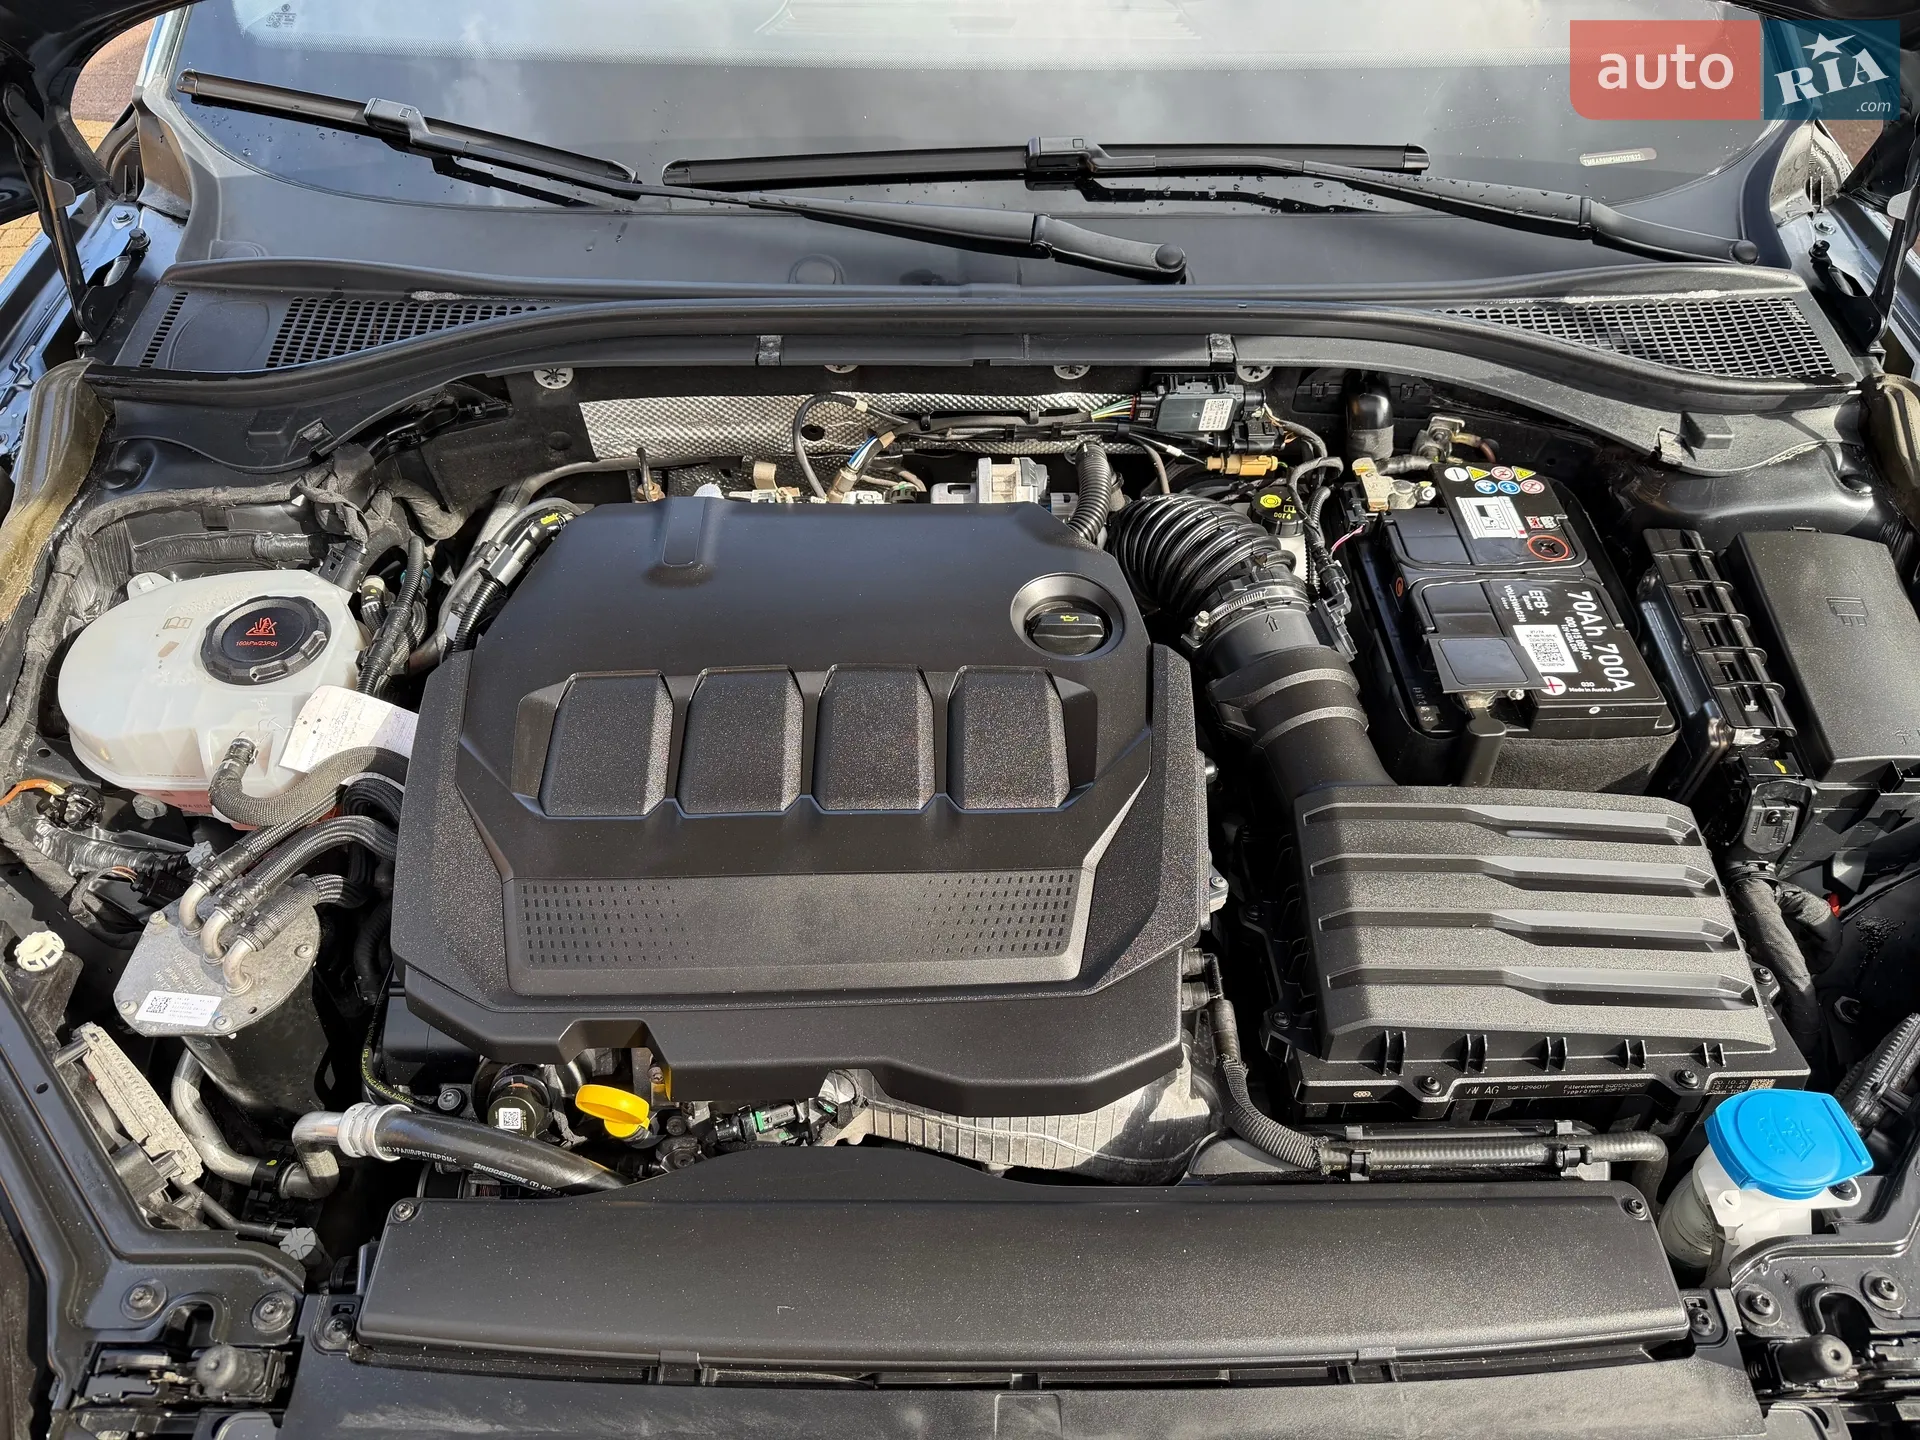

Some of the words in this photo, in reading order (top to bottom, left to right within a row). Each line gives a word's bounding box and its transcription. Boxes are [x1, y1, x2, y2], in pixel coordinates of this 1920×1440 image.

[1504, 584, 1527, 623] VOLKSWAGEN
[1528, 590, 1550, 617] EFB+
[1567, 591, 1607, 637] 70Ah
[1593, 643, 1635, 691] 700A
[1484, 1085, 1500, 1095] AG
[472, 1161, 529, 1184] BRIDGESTONE
